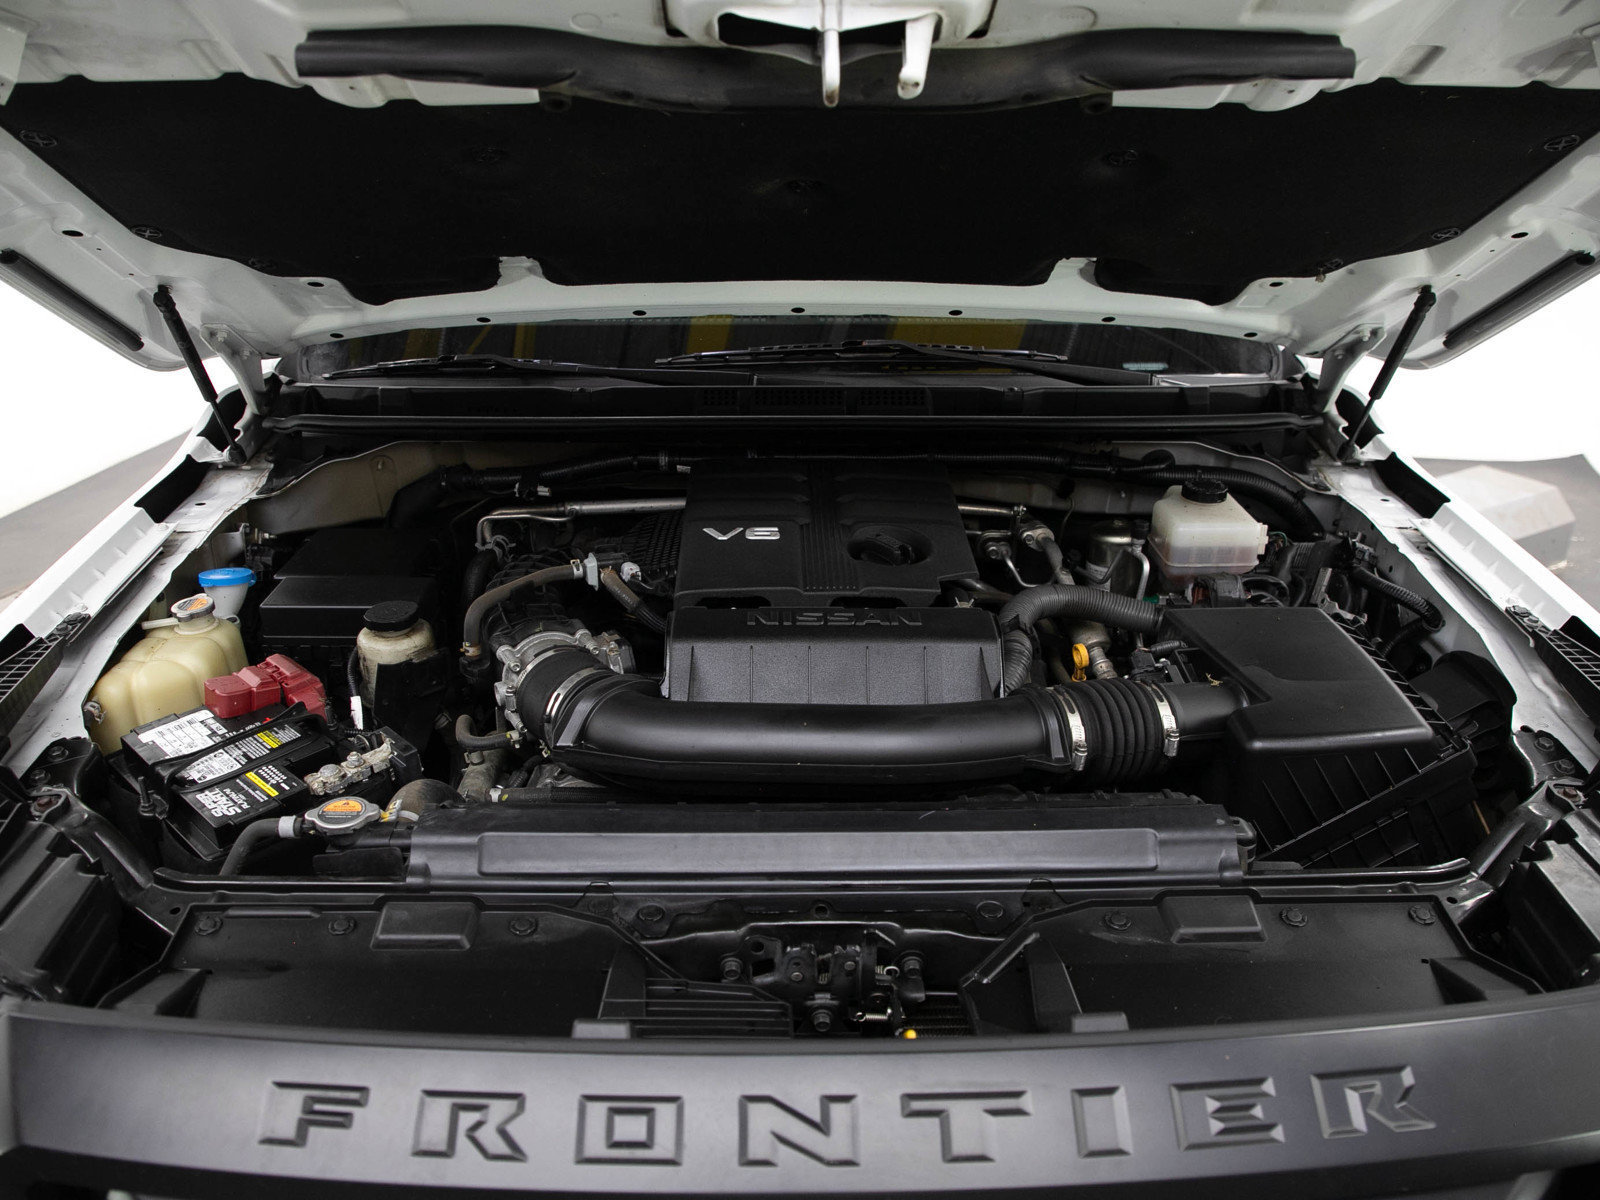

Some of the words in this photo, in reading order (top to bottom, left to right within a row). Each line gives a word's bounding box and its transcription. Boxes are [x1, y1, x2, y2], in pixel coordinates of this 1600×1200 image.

[702, 526, 780, 541] V6
[746, 610, 923, 626] NISSAN
[204, 789, 242, 816] START
[258, 1065, 1437, 1167] FRONTIER
